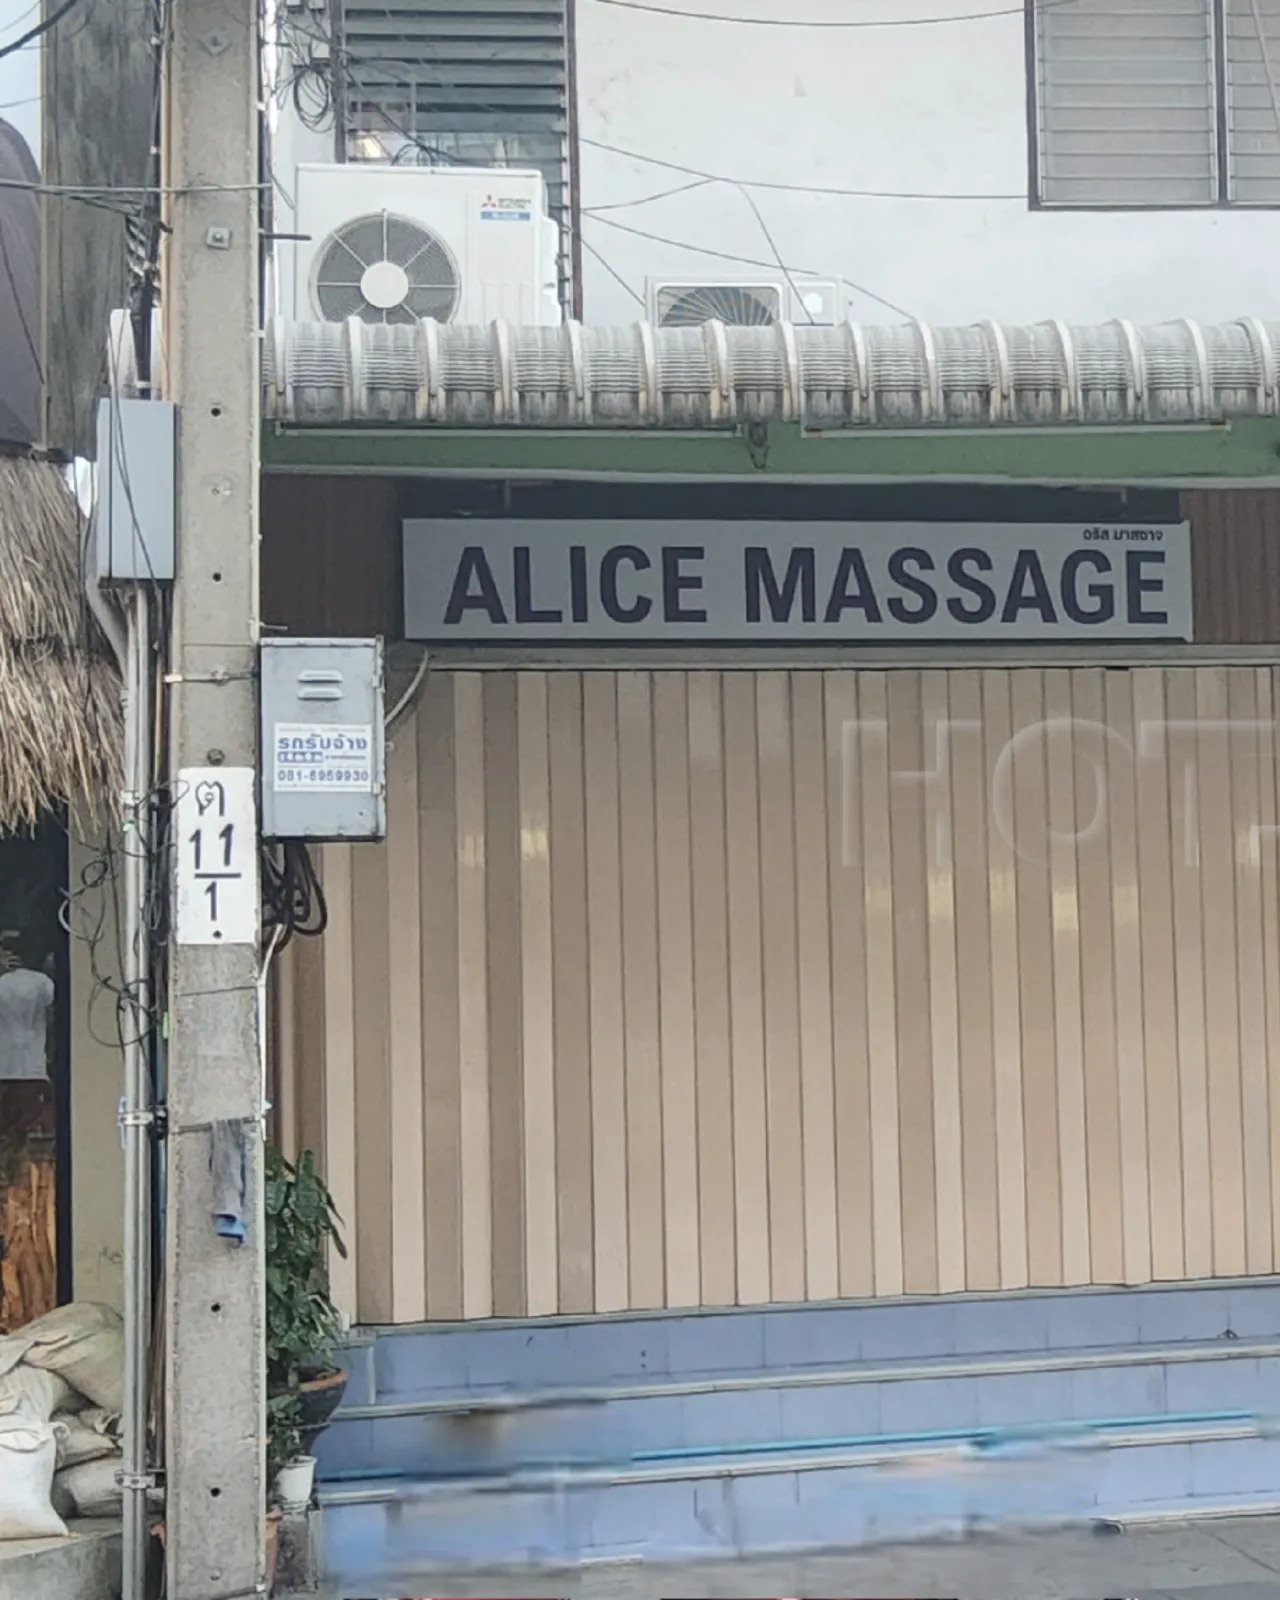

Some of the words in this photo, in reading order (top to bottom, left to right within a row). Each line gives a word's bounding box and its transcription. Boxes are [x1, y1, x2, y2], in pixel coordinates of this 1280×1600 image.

[443, 546, 707, 625] ALICE
[744, 547, 1169, 626] MASSAGE
[189, 823, 233, 870] 11
[204, 881, 217, 921] 1
